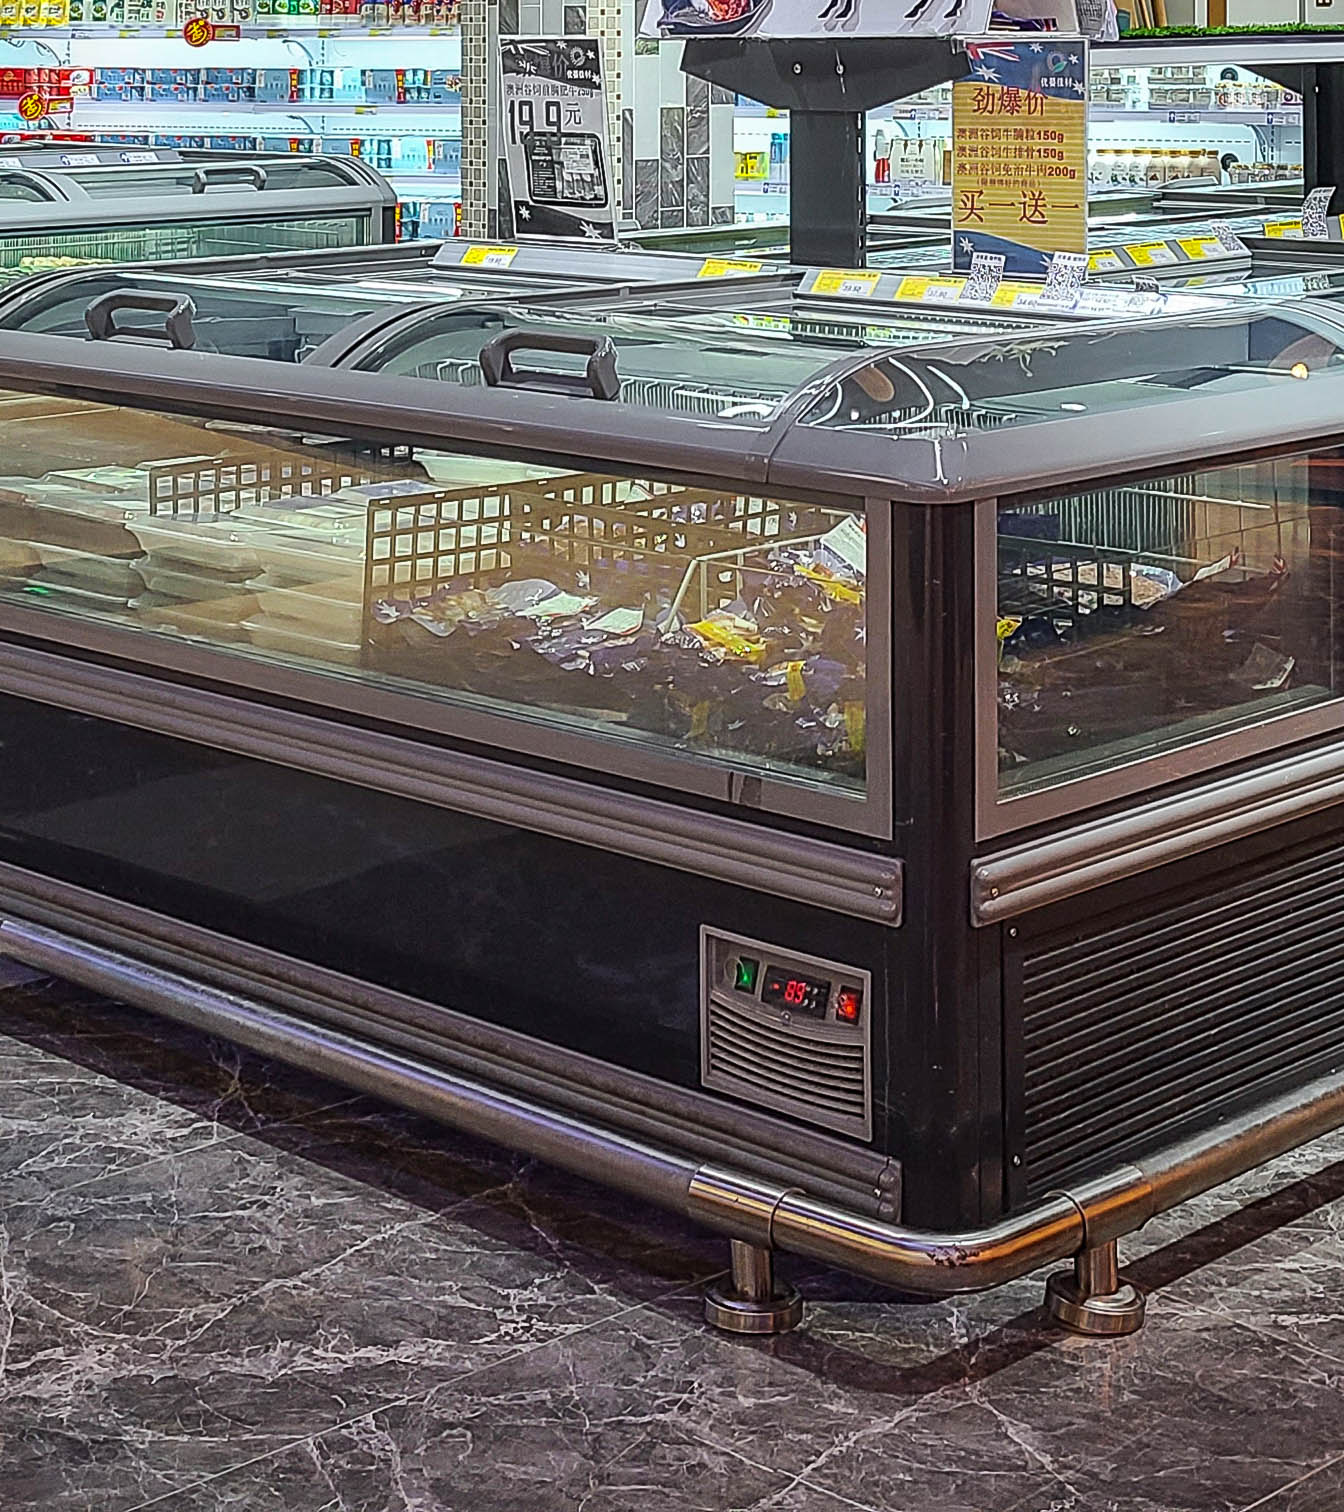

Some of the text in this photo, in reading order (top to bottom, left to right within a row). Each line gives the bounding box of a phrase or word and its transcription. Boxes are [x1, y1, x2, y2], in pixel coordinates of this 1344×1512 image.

[971, 86, 1048, 116] 劲爆价
[958, 189, 1080, 225] 买一送一
